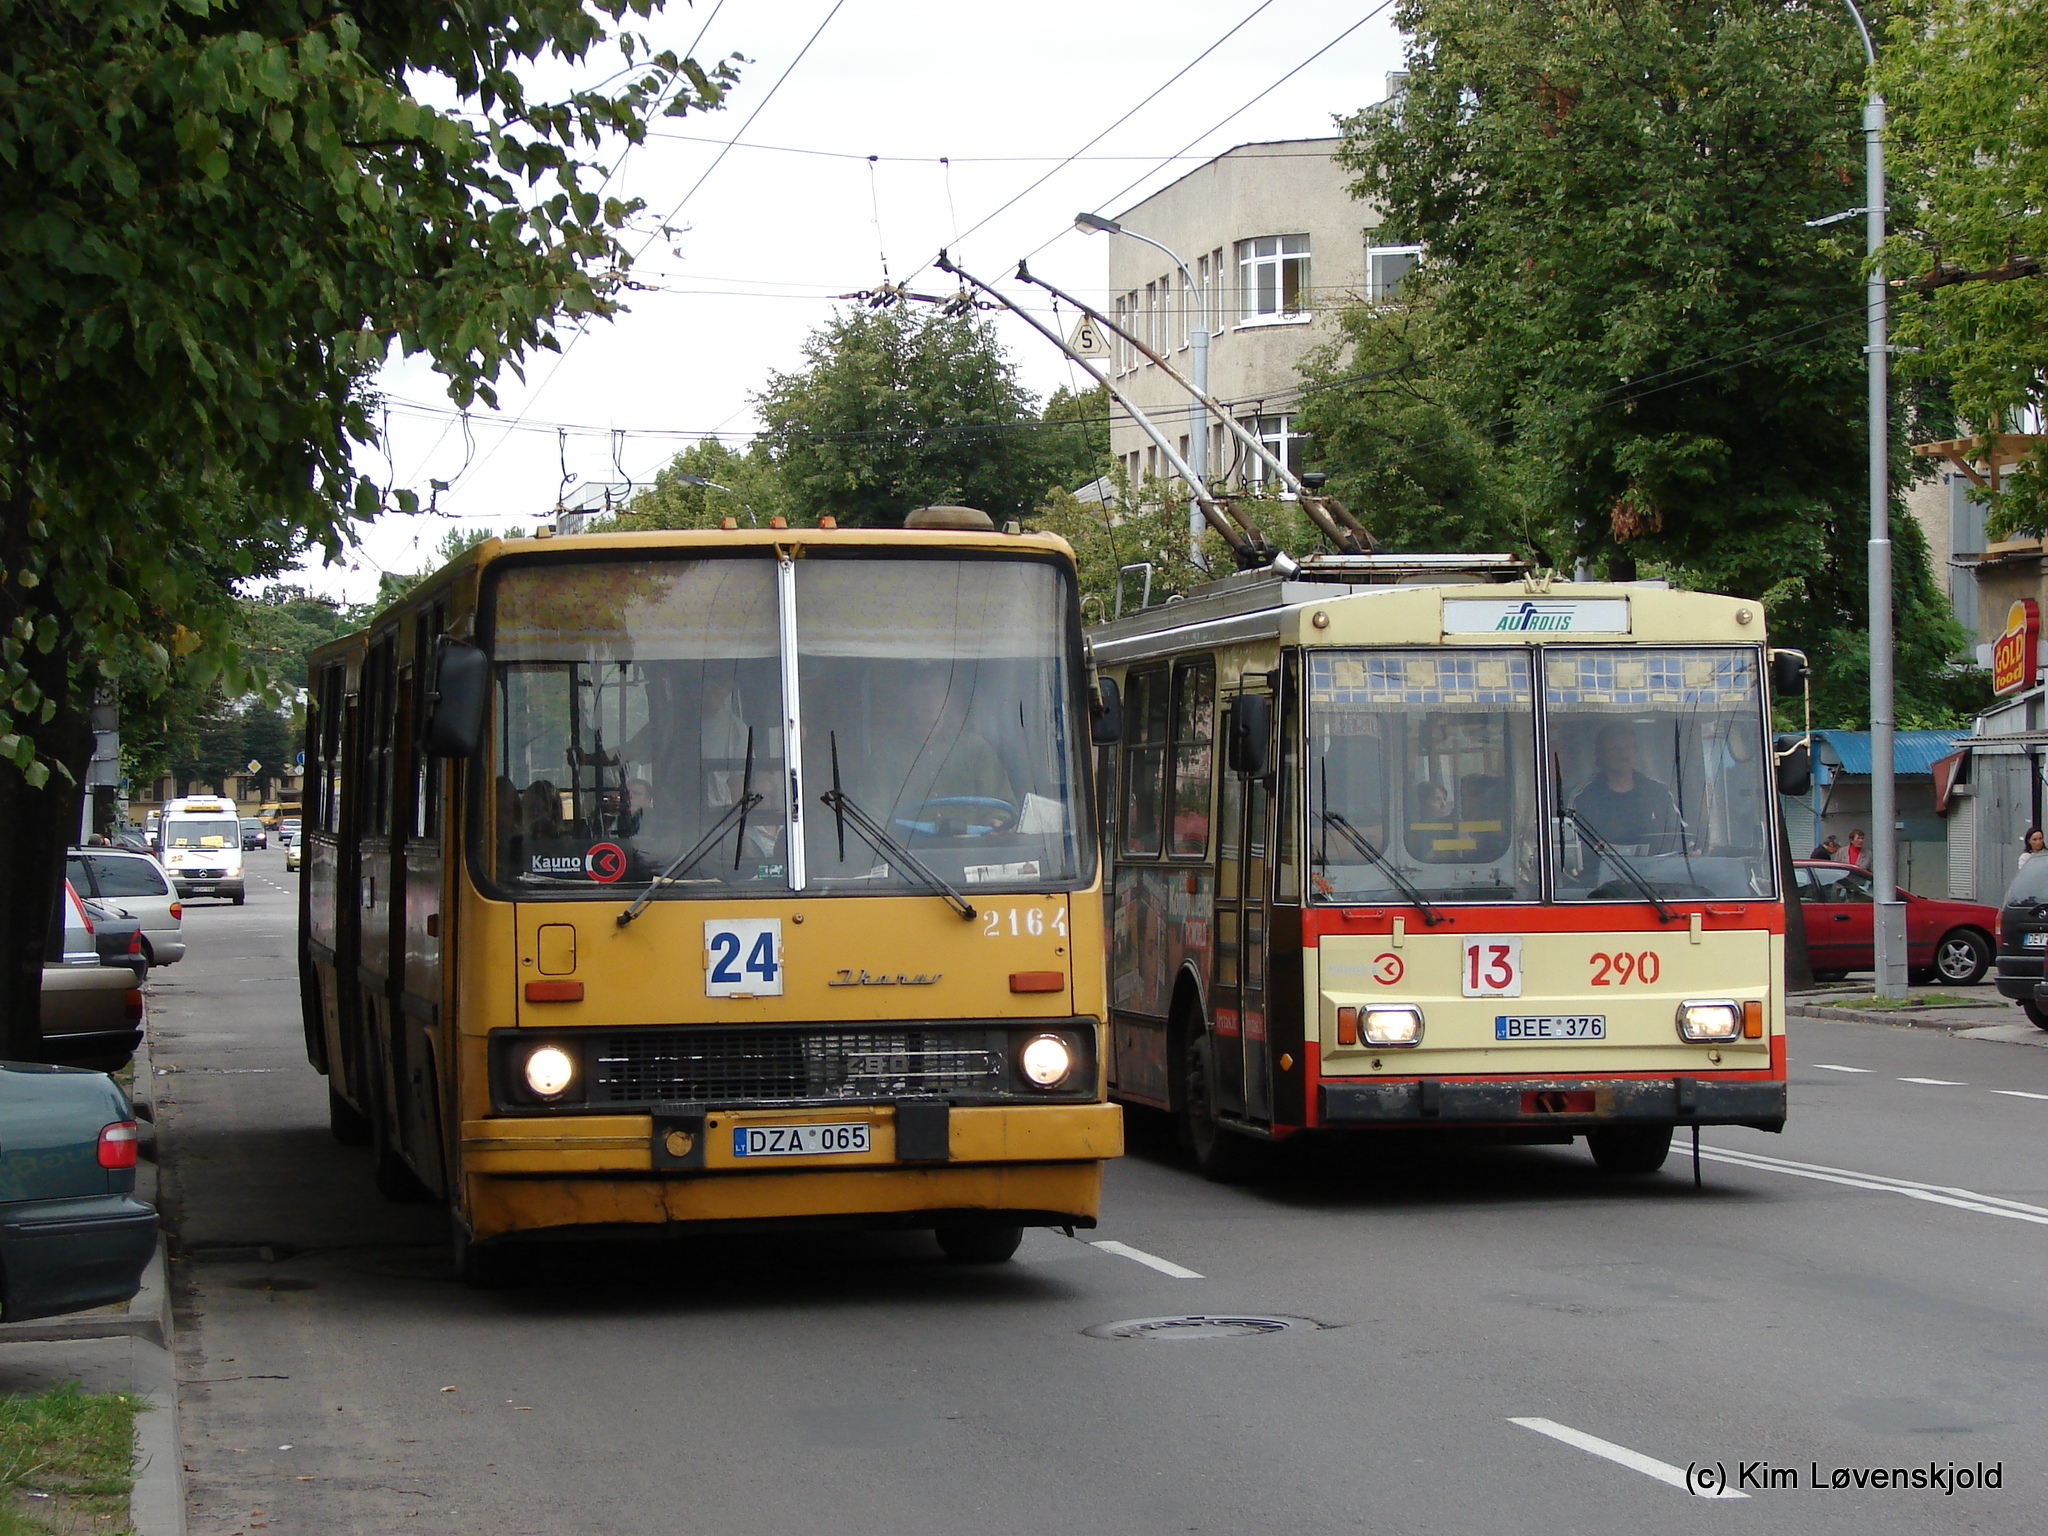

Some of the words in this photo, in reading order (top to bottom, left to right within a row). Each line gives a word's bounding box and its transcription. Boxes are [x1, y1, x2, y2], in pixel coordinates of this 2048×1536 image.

[1081, 330, 1093, 349] S
[1495, 608, 1572, 631] AUTROLIS
[1995, 634, 2023, 673] GOLD
[1996, 661, 2022, 690] food
[532, 855, 581, 869] Kauno
[983, 907, 1067, 937] 2164
[710, 931, 778, 983] 24
[1466, 943, 1513, 990] 13
[1589, 950, 1660, 986] 290
[828, 969, 943, 986] Ikarus
[1509, 1019, 1551, 1037] BEE
[1566, 1018, 1602, 1036] 376
[735, 1144, 745, 1152] LT
[750, 1129, 803, 1152] DZA
[821, 1127, 865, 1150] 065
